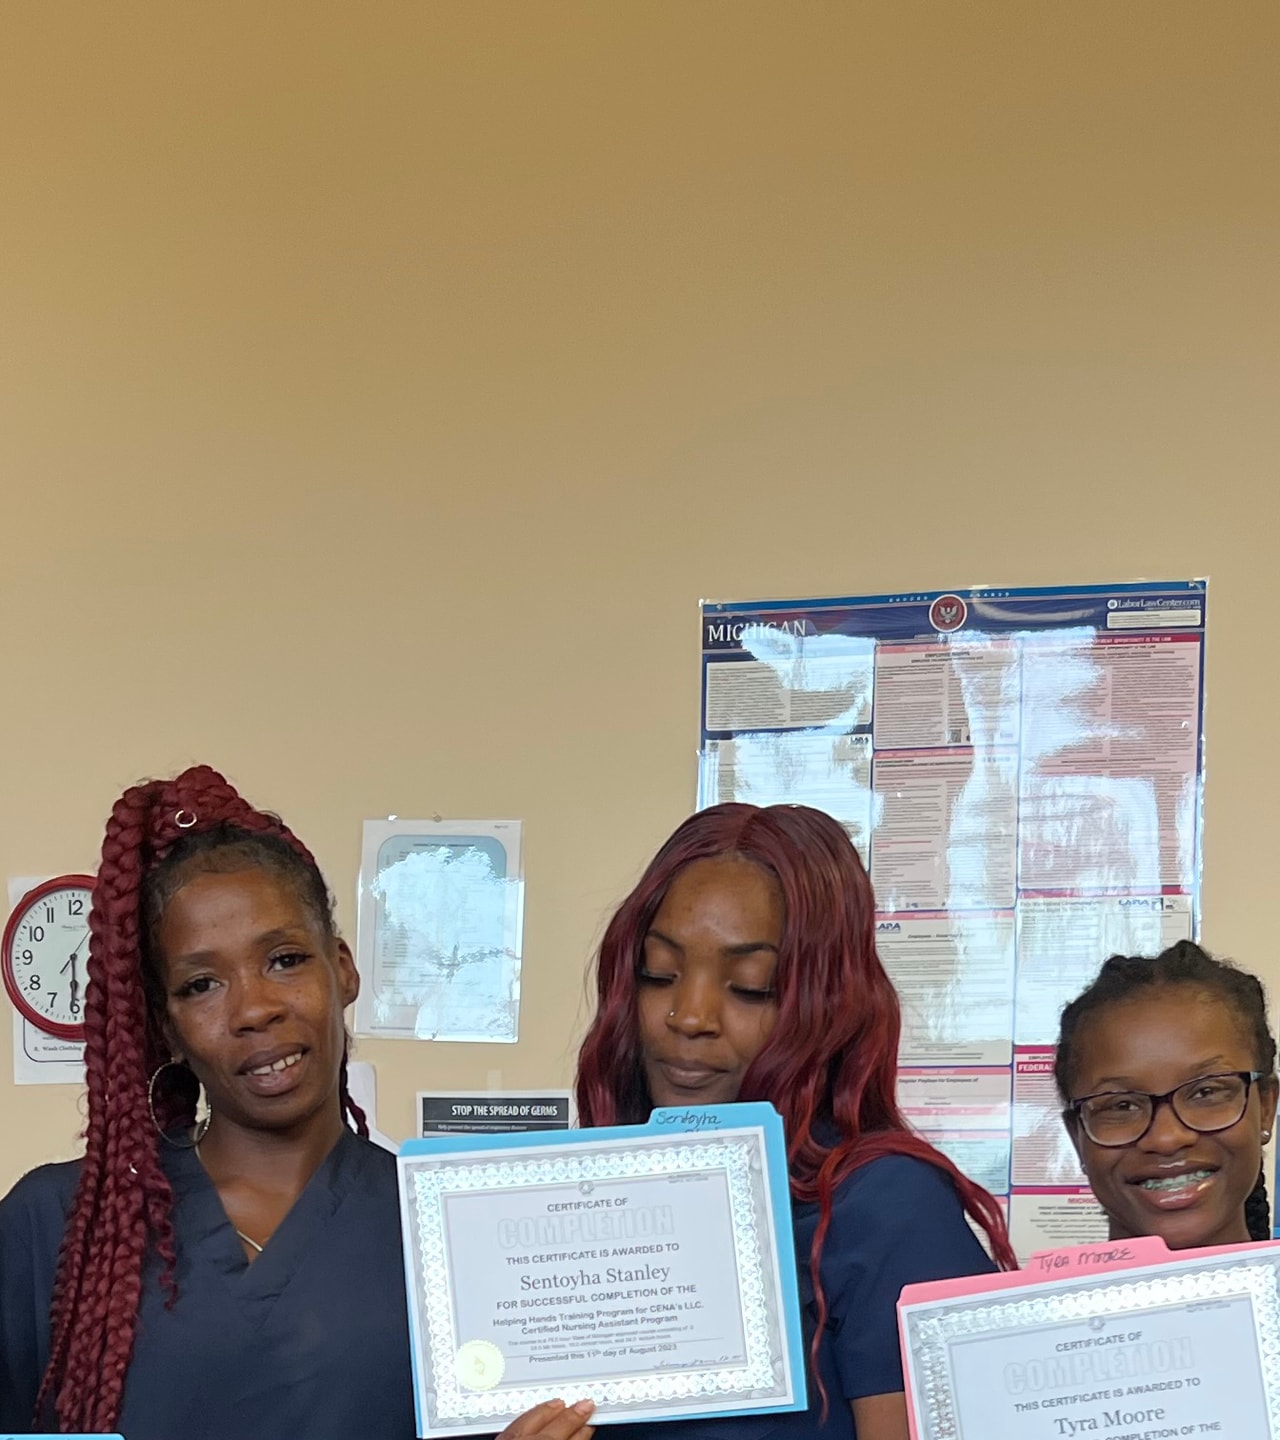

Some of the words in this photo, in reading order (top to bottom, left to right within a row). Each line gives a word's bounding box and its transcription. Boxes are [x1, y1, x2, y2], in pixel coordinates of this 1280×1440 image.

[707, 620, 806, 642] MICHIGAN
[47, 907, 54, 923] 11
[69, 900, 83, 915] 12
[29, 926, 44, 942] 10
[22, 949, 33, 965] 9
[29, 974, 41, 990] 8
[47, 992, 57, 1008] 7
[70, 998, 80, 1014] 6
[452, 1105, 472, 1115] STOP
[473, 1105, 488, 1115] THE
[489, 1105, 519, 1116] SPREAD
[520, 1105, 530, 1115] OF
[531, 1105, 558, 1116] GERMS
[656, 1110, 722, 1129] Sentoyha
[546, 1198, 612, 1213] CERTIFICATE
[614, 1197, 628, 1206] OF
[497, 1205, 674, 1249] COMPLETION
[520, 1269, 602, 1291] Sentoyha
[606, 1263, 670, 1283] Stanley
[1055, 1333, 1126, 1353] CERTIFICATE
[1127, 1330, 1142, 1342] OF
[1003, 1336, 1195, 1395] COMPLETION
[1055, 1417, 1098, 1437] Tyra
[1101, 1408, 1165, 1428] Moore
